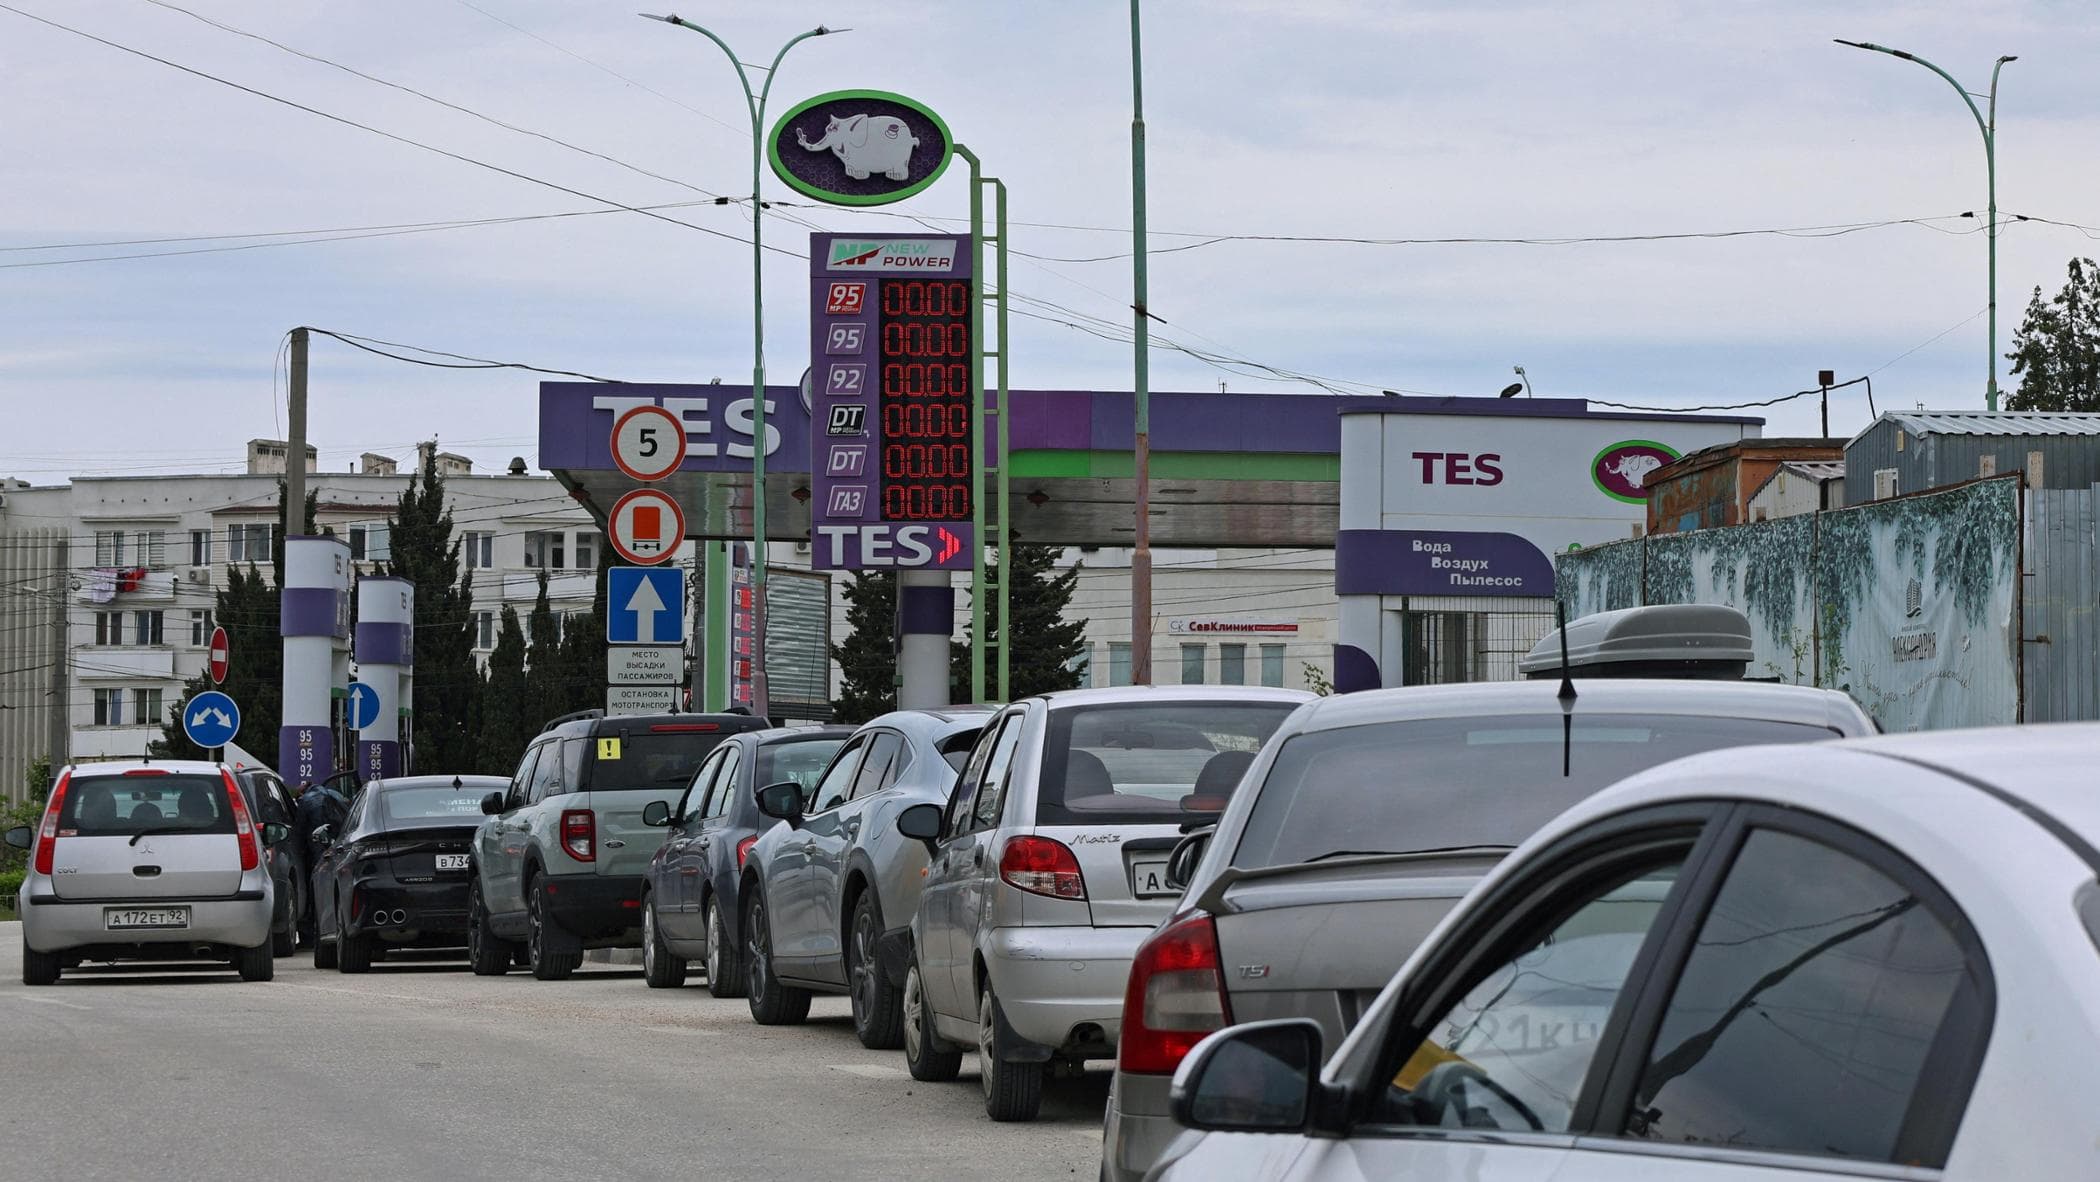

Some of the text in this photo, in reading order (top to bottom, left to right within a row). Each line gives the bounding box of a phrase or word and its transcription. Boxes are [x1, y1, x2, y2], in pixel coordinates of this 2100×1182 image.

[832, 243, 881, 265] NP
[886, 244, 930, 254] NEW
[883, 257, 951, 267] POWER
[834, 286, 859, 305] 95
[833, 329, 860, 349] 95
[833, 369, 860, 389] 92
[832, 407, 863, 426] DT
[639, 428, 658, 457] 5
[831, 451, 863, 471] DT
[1412, 452, 1504, 486] TES
[833, 492, 861, 511] ГАЗ
[818, 525, 933, 567] TES
[1413, 540, 1452, 554] Вода
[1431, 557, 1489, 571] Воздух
[1450, 573, 1522, 587] Пылесос
[626, 662, 666, 670] ВЫСАДКИ
[300, 730, 312, 742] 95
[300, 749, 313, 761] 95
[371, 744, 382, 755] 95
[300, 765, 312, 777] 92
[370, 760, 382, 770] 95
[1069, 834, 1120, 845] Matiz
[169, 911, 182, 920] 92
